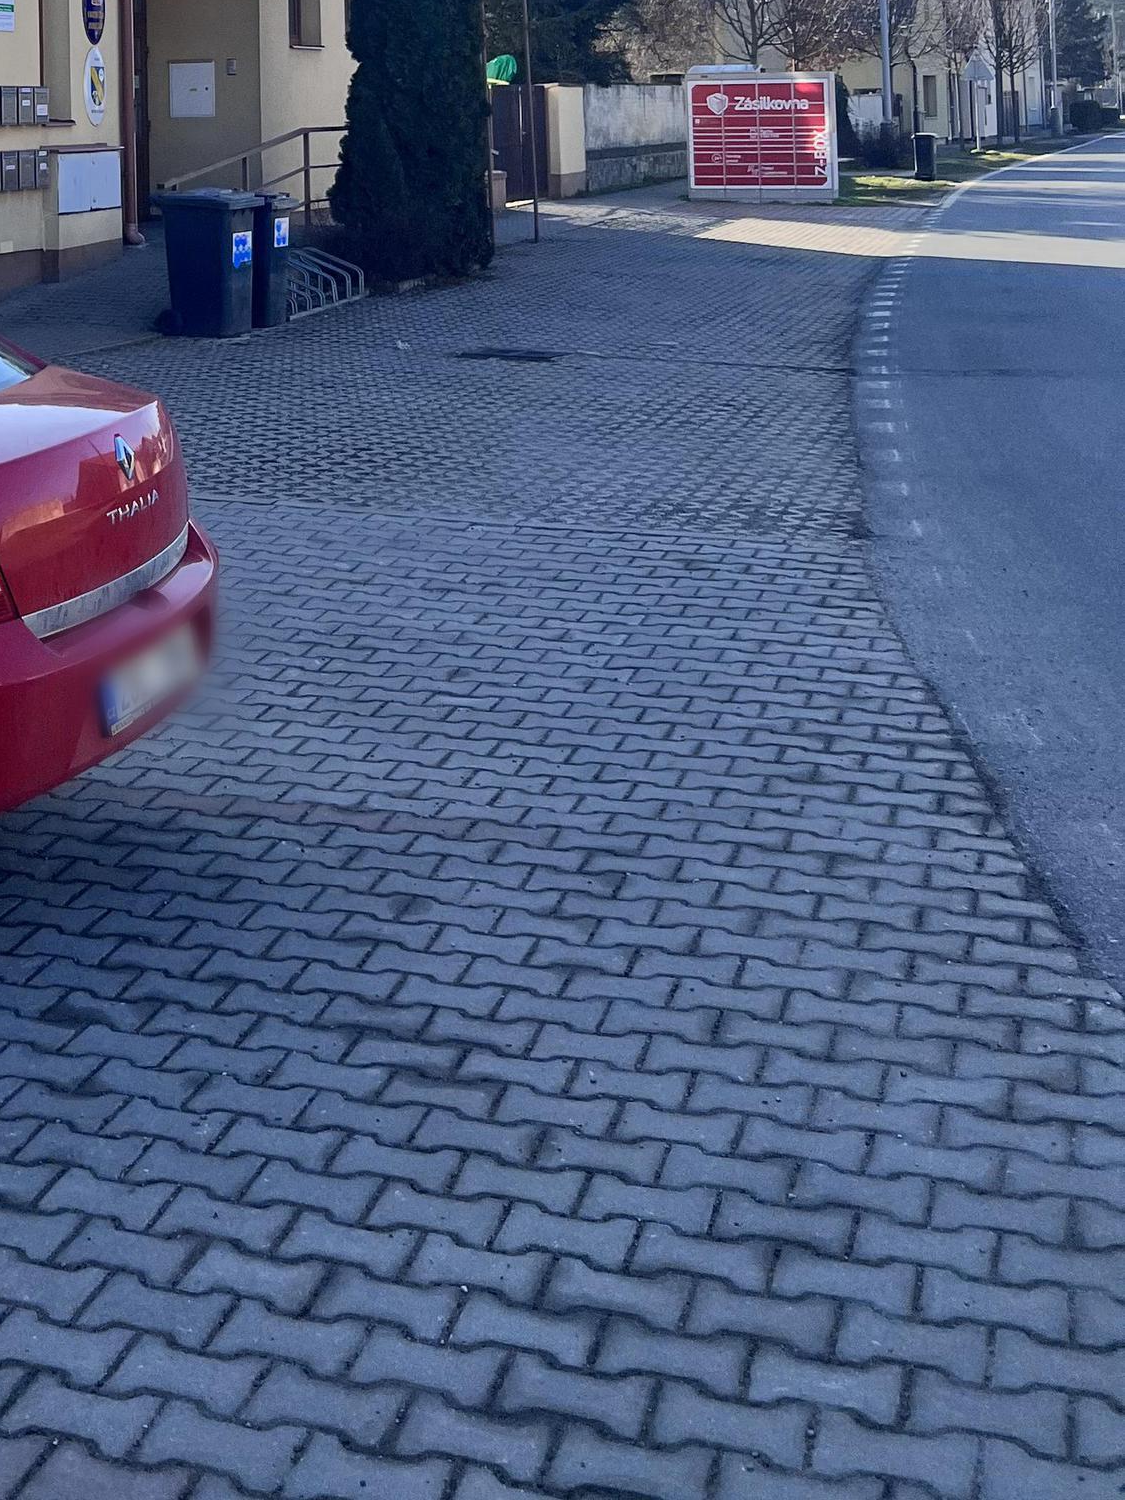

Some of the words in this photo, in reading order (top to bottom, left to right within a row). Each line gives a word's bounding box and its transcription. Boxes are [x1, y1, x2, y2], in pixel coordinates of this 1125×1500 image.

[734, 96, 810, 111] Zásilkovna
[813, 130, 827, 177] Z-BOX
[106, 489, 160, 525] THALIA
